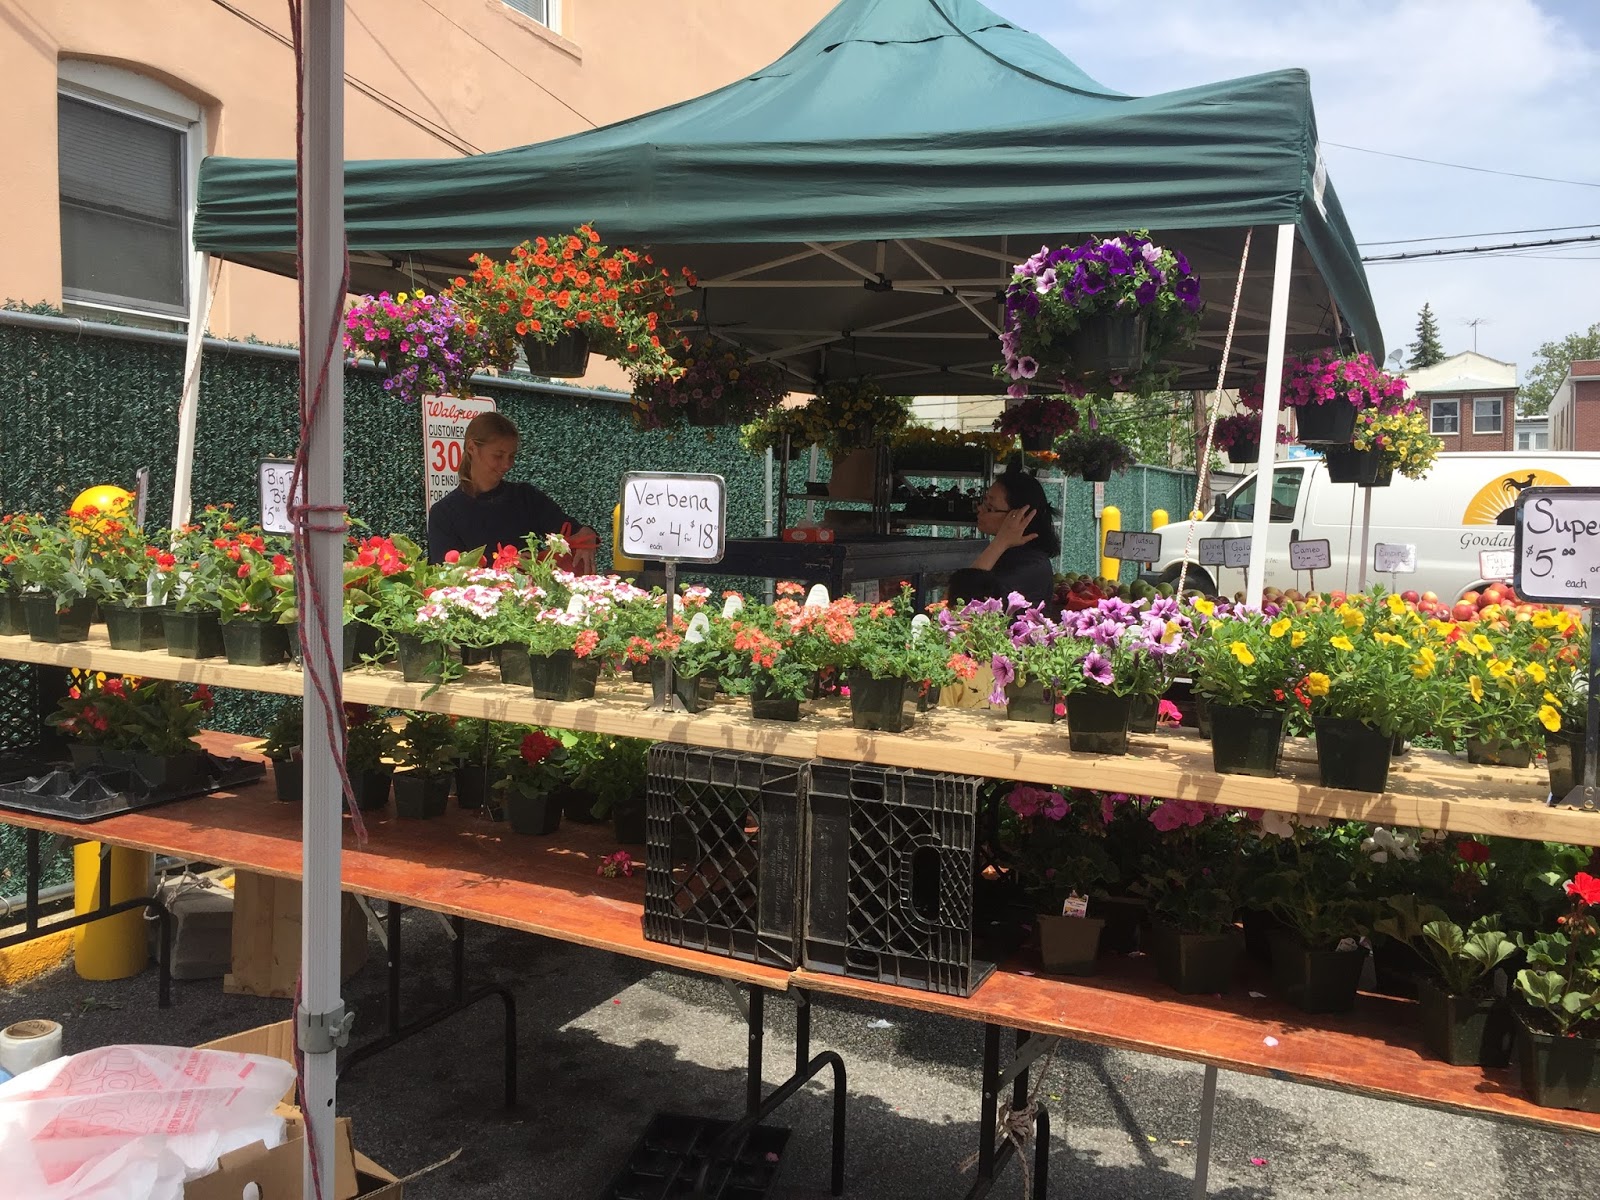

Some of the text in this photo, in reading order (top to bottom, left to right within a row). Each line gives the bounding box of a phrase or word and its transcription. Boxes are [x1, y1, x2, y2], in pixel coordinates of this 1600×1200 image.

[427, 401, 484, 424] Walgree
[428, 424, 465, 437] CUSTOMER
[431, 440, 462, 473] 30
[265, 467, 286, 493] Big
[431, 475, 459, 487] TO ENSU
[633, 482, 712, 512] Verbena
[1526, 498, 1600, 543] Supe
[670, 522, 681, 547] 4
[1460, 531, 1515, 549] Goodal
[1293, 544, 1321, 554] Cameo
[1565, 578, 1587, 589] each
